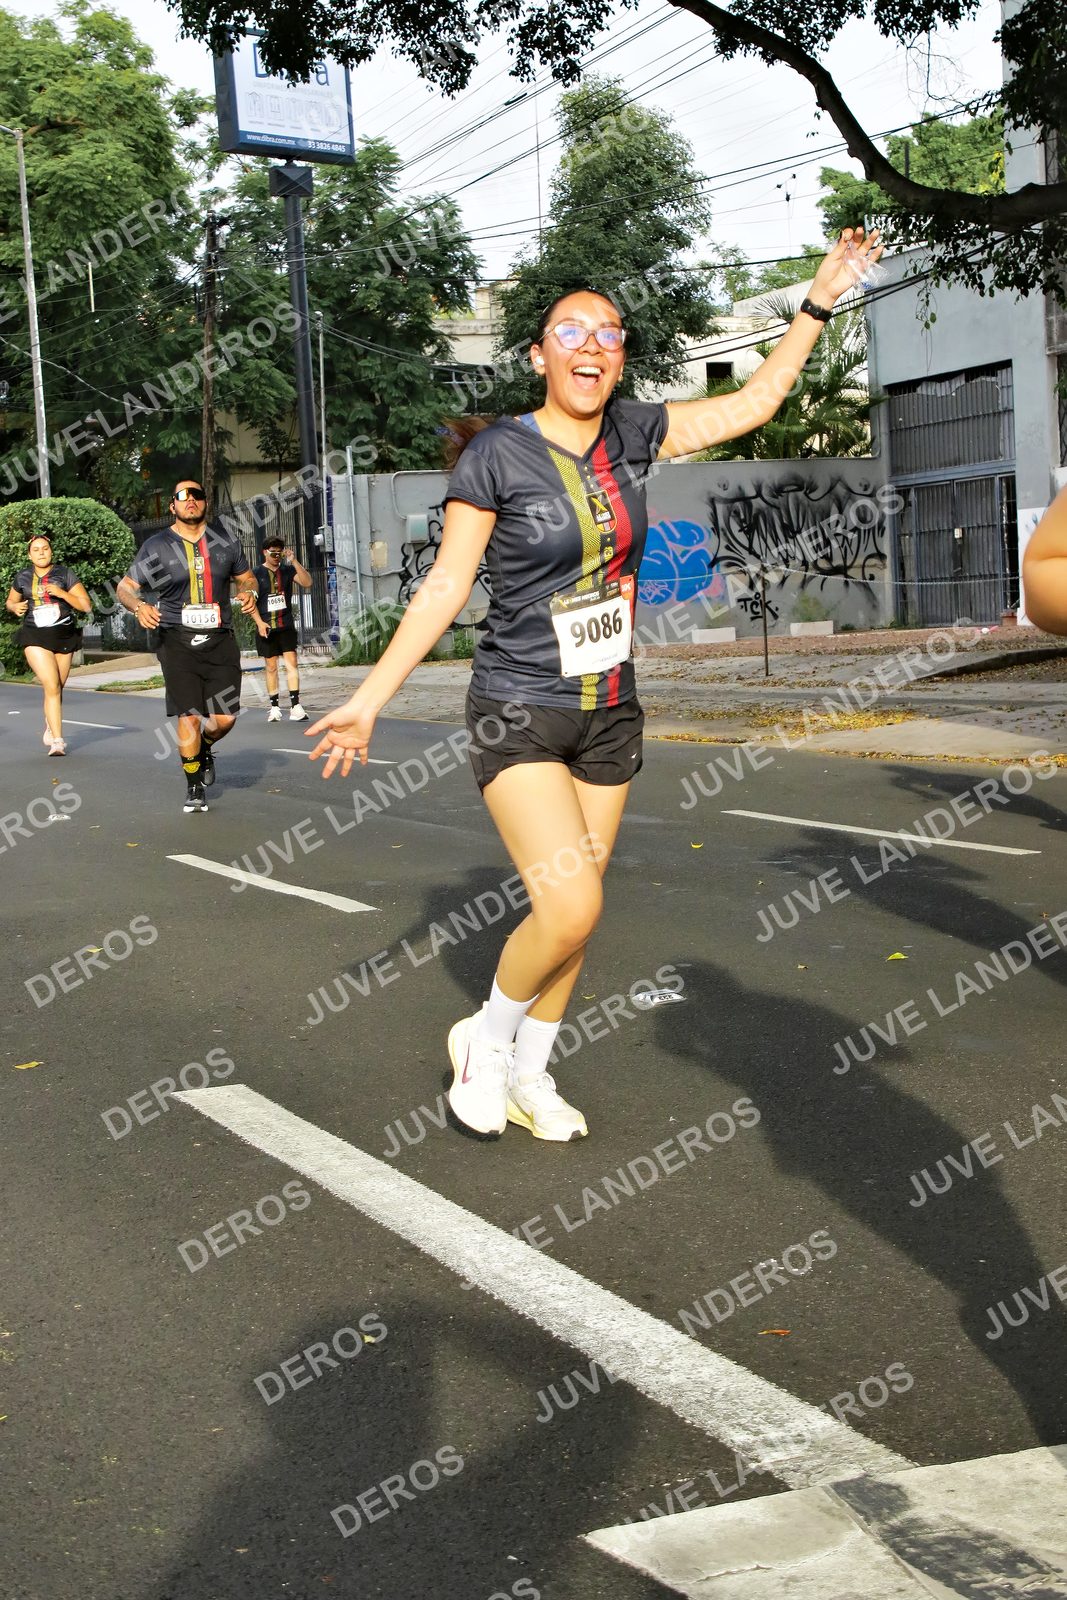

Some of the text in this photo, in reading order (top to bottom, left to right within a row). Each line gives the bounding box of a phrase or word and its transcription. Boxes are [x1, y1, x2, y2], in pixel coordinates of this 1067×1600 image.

[307, 140, 316, 149] 33
[185, 613, 216, 624] 10156
[570, 607, 622, 648] 9086
